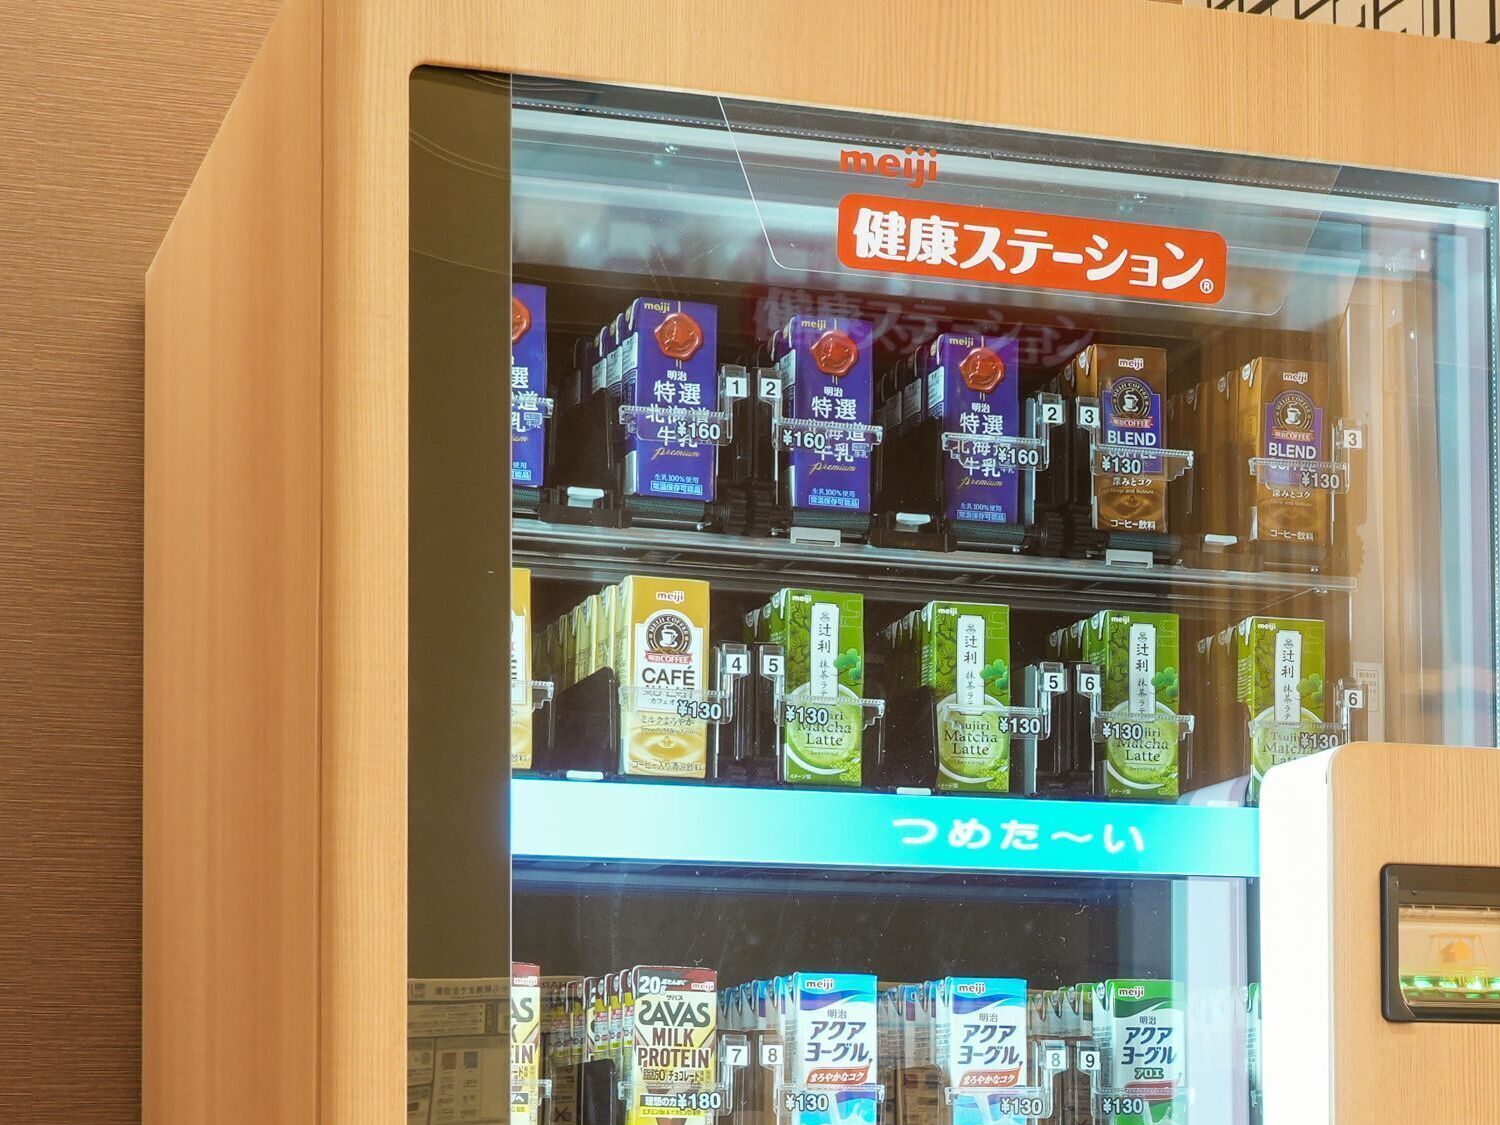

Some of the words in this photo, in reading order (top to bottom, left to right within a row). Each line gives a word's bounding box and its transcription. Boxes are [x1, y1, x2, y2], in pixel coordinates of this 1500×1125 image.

[840, 148, 939, 188] meiji
[644, 302, 670, 313] meiji
[801, 319, 827, 331] meiji
[949, 336, 974, 348] meiji
[1118, 358, 1144, 371] meiji
[667, 370, 687, 381] 明治
[1282, 371, 1308, 385] meiji
[654, 380, 701, 405] 特選
[731, 380, 741, 394] 1
[766, 381, 776, 395] 2
[824, 386, 844, 397] 明治
[811, 396, 857, 420] 特選
[971, 402, 991, 413] 明治
[1047, 408, 1057, 421] 2
[1084, 409, 1094, 423] 3
[677, 421, 721, 440] ¥160
[960, 412, 1003, 435] 特選
[783, 430, 826, 450] ¥160
[1107, 430, 1157, 446] BLEND
[1348, 433, 1358, 446] 3
[651, 447, 700, 461] premium
[998, 447, 1039, 466] ¥160
[1268, 442, 1317, 460] BLEND
[809, 462, 857, 475] premium
[964, 457, 1001, 477] 牛乳
[1101, 455, 1142, 475] ¥130
[958, 477, 1003, 490] premium
[1301, 472, 1340, 489] ¥130
[1110, 519, 1156, 530] コーヒー飲料
[1270, 529, 1313, 541] コーヒー飲料
[656, 591, 684, 604] meiji
[792, 594, 812, 604] meiji
[937, 607, 958, 617] meiji
[1111, 615, 1130, 625] meiji
[1257, 623, 1276, 632] meiji
[818, 623, 832, 654] 辻利
[963, 635, 978, 665] 辻利
[731, 656, 742, 671] 4
[1135, 643, 1150, 672] 辻利
[1281, 650, 1295, 679] 辻利
[768, 658, 778, 672] 5
[642, 666, 695, 686] CAFÉ
[1049, 676, 1058, 690] 5
[1085, 677, 1095, 690] 6
[1348, 692, 1358, 706] 6
[677, 700, 722, 720] ¥130
[786, 705, 829, 725] ¥130
[998, 717, 1041, 734] ¥130
[1102, 722, 1143, 741] ¥130
[807, 733, 843, 746] Latte
[944, 730, 998, 743] Matcha
[1300, 732, 1339, 750] ¥130
[953, 743, 989, 755] Latte
[1126, 750, 1161, 762] Latte
[691, 982, 714, 991] meiji
[806, 979, 834, 991] meiji
[958, 983, 985, 995] meiji
[1118, 987, 1144, 999] meiji
[638, 1000, 711, 1027] SAVAS
[827, 1009, 847, 1019] 明治
[979, 1013, 998, 1023] 明治
[1139, 1016, 1157, 1025] 明治
[652, 1027, 694, 1047] MILK
[810, 1021, 866, 1041] アクア
[963, 1025, 1017, 1043] アクア
[1125, 1027, 1173, 1044] アクア
[637, 1047, 710, 1068] PROTEIN
[732, 1049, 742, 1063] 7
[768, 1048, 777, 1062] 8
[1051, 1053, 1061, 1067] 8
[1085, 1054, 1095, 1068] 9
[810, 1073, 864, 1083] まろやかなコク
[962, 1074, 1016, 1085] まろやかなコク
[1134, 1068, 1164, 1079] アロエ
[677, 1092, 721, 1110] ¥180
[785, 1094, 829, 1112] ¥130
[1001, 1099, 1044, 1116] ¥130
[1102, 1098, 1143, 1114] ¥130
